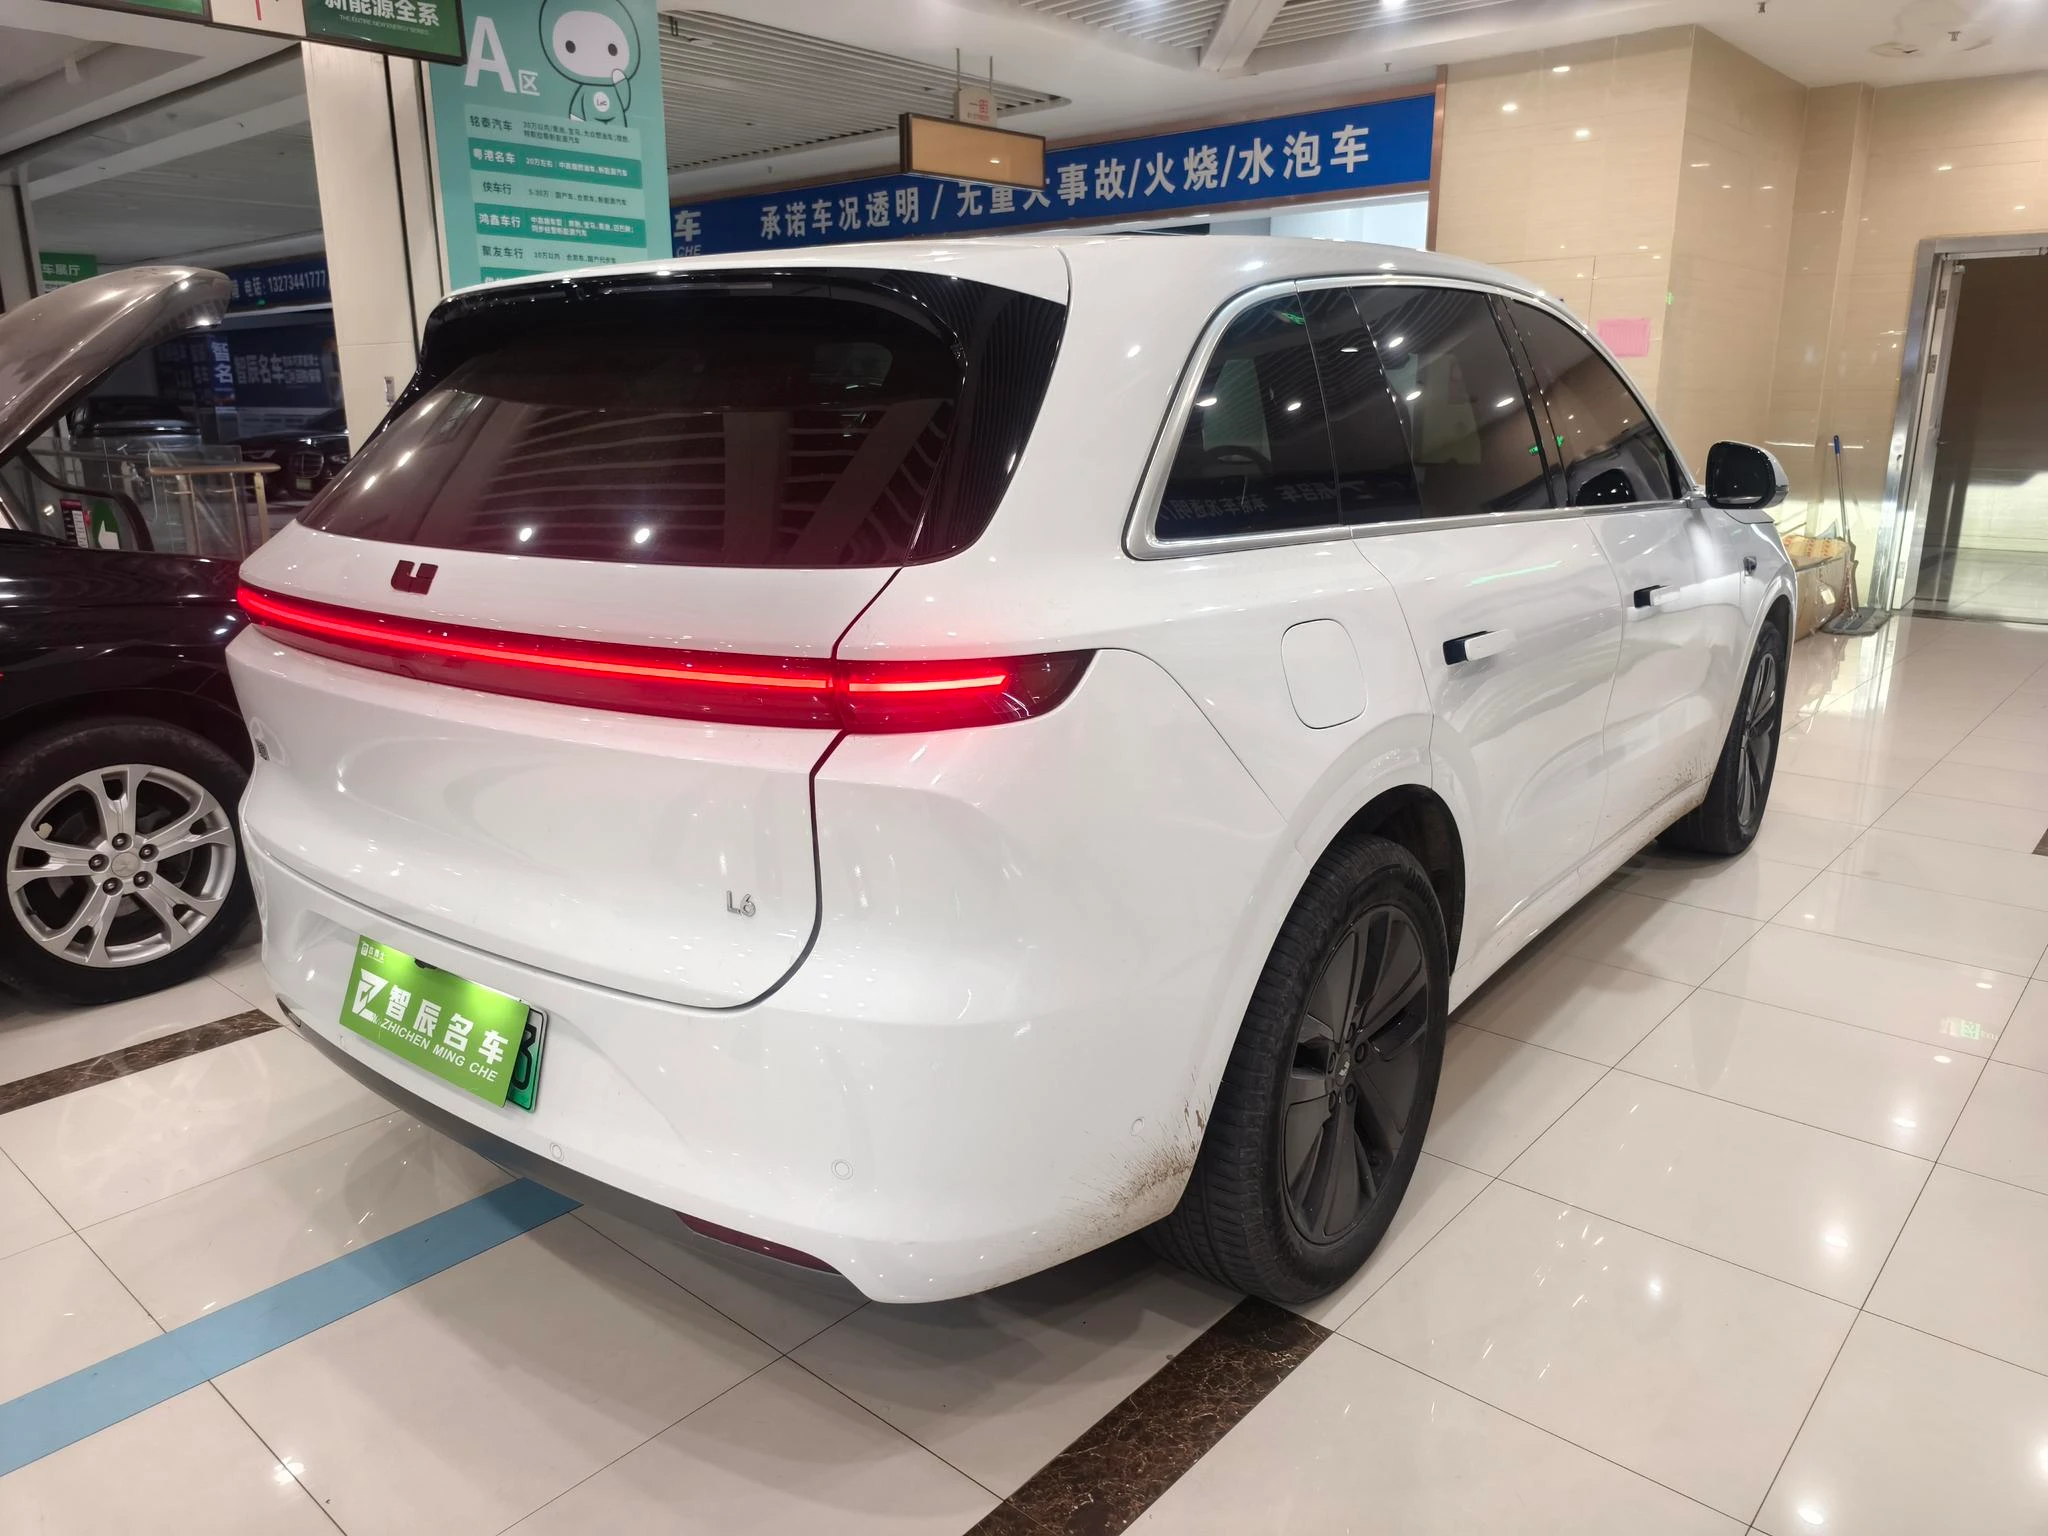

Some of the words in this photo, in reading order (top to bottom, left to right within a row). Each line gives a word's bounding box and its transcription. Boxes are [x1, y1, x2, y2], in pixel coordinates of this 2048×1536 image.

[464, 15, 517, 94] A
[518, 69, 541, 96] 区
[672, 209, 702, 242] 车
[726, 890, 757, 917] L6
[380, 1018, 431, 1050] ZHICHEN
[432, 1044, 466, 1067] MING
[469, 1062, 499, 1083] CHE
[385, 984, 509, 1065] 智辰名车
